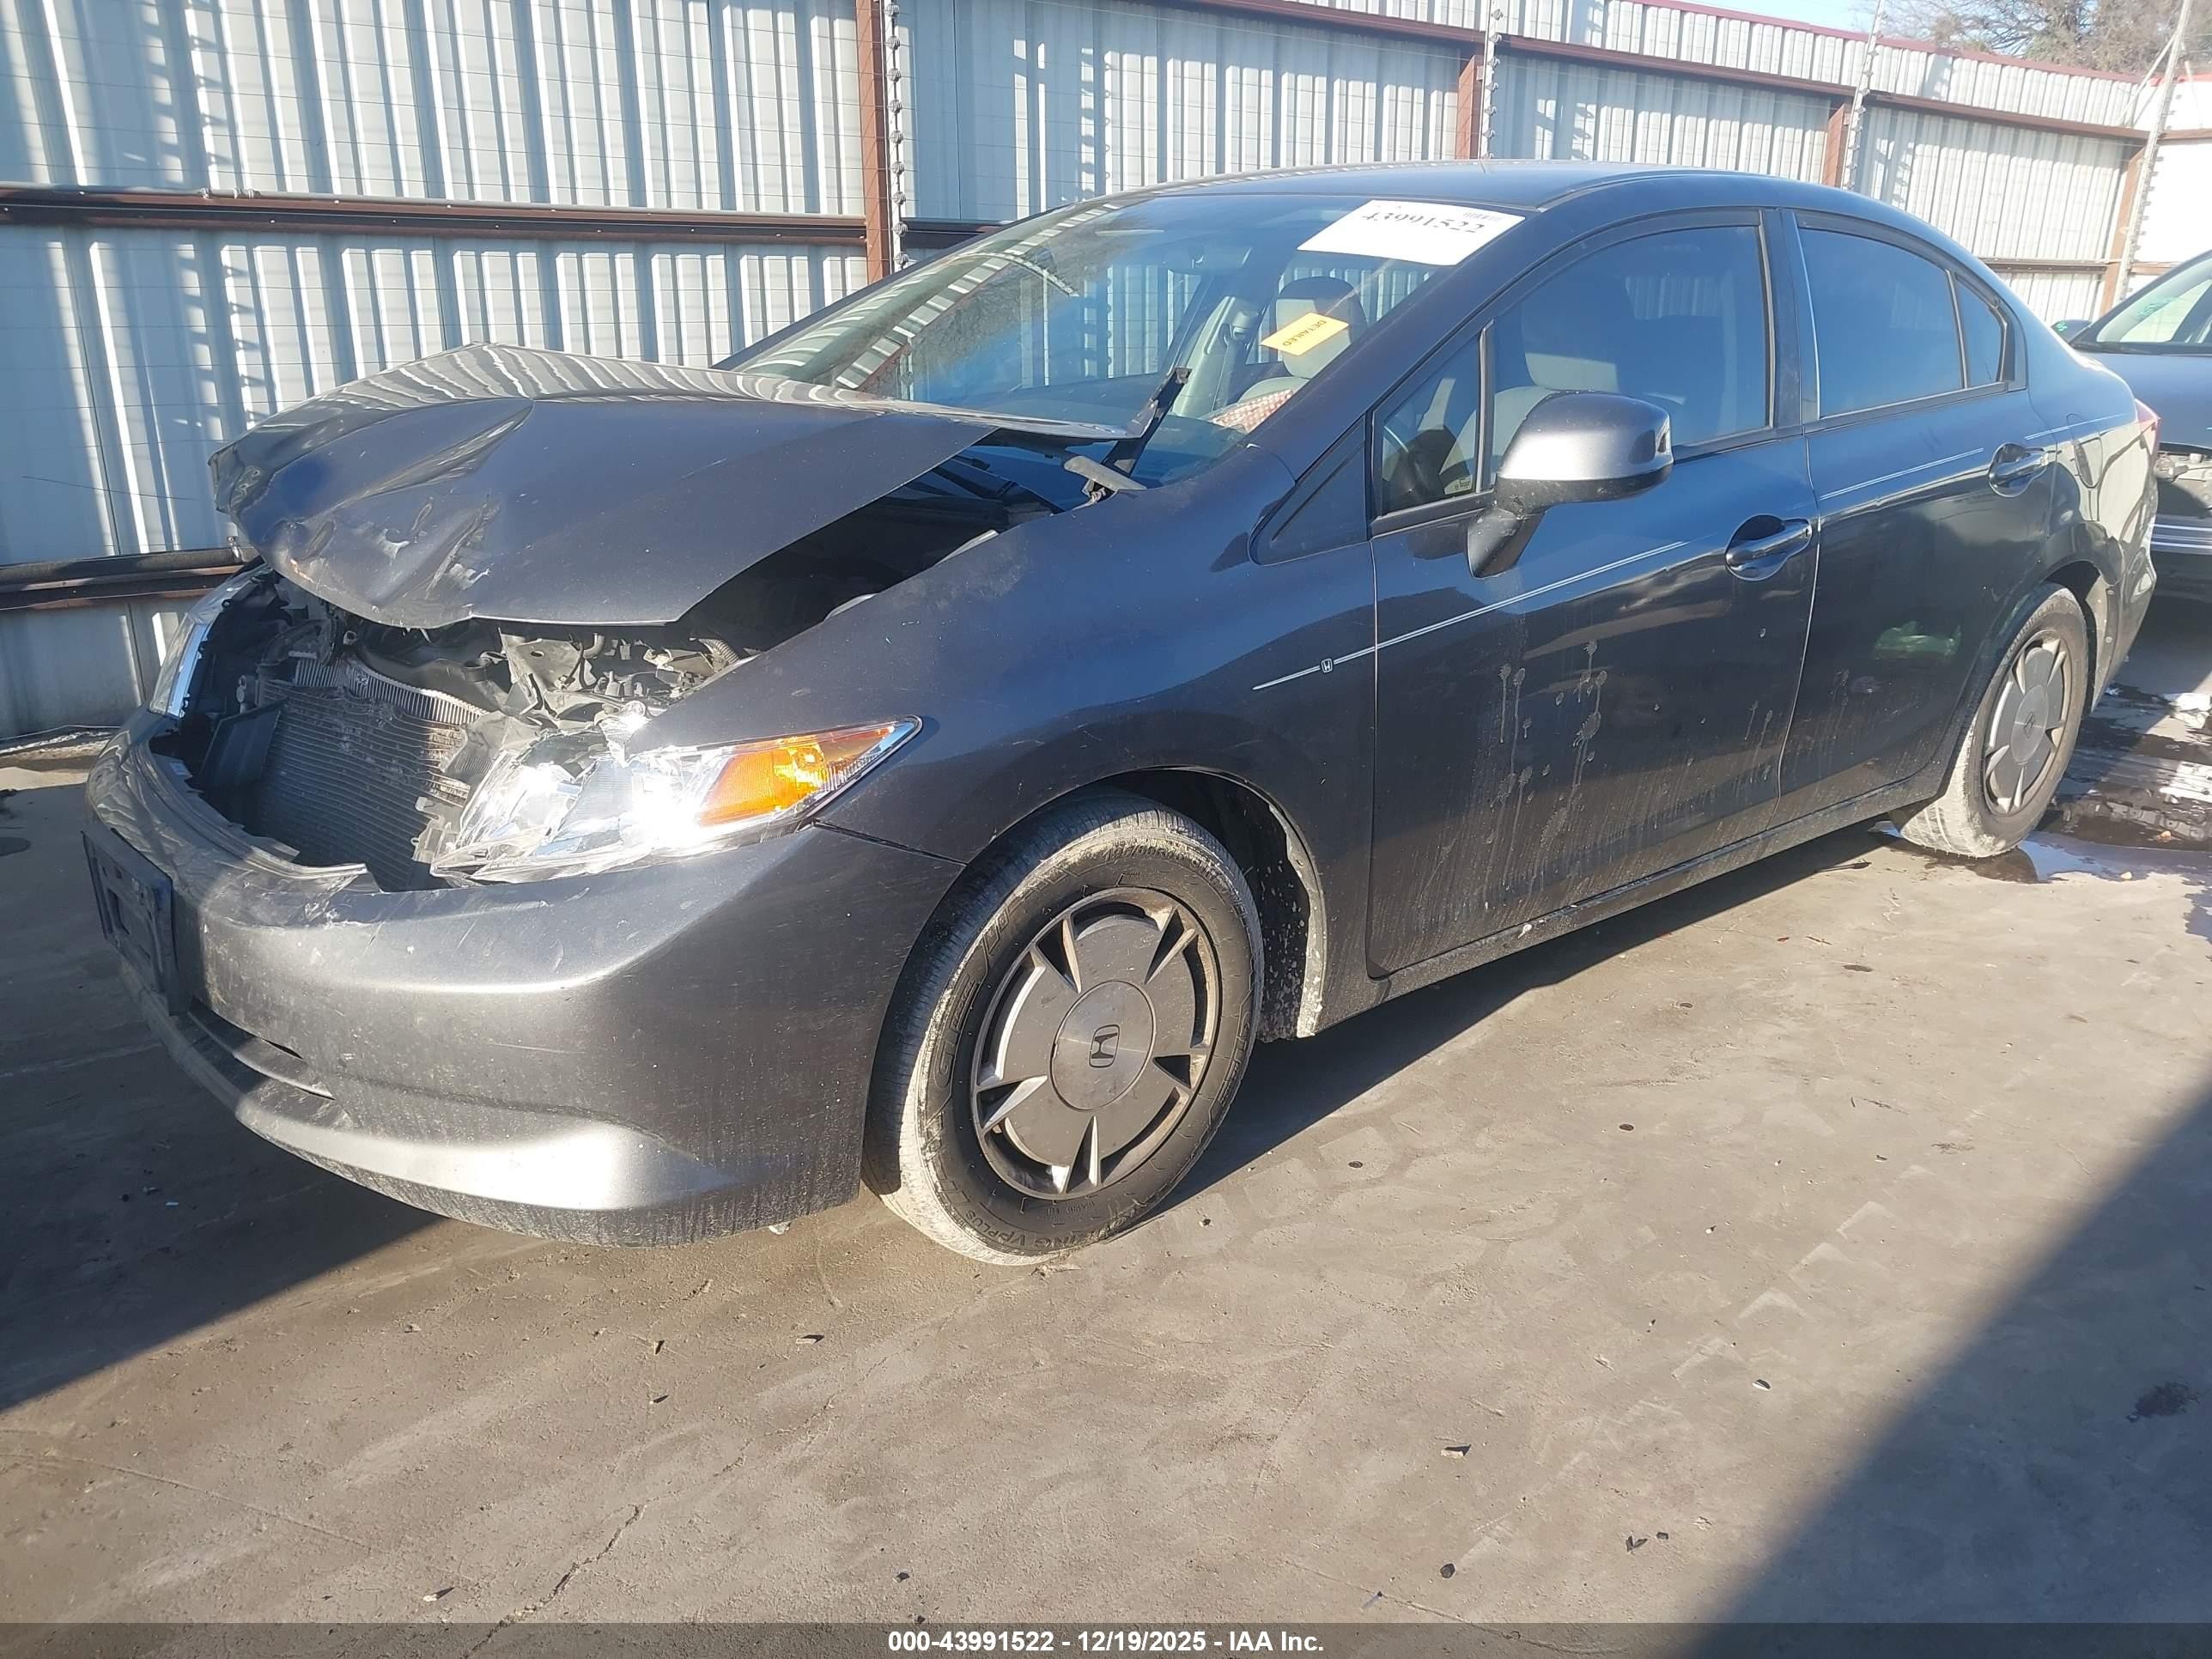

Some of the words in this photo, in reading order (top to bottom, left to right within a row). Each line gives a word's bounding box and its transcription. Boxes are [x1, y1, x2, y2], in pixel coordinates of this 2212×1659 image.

[1362, 212, 1485, 233] 43991522
[1283, 319, 1327, 346] DETAILED
[933, 1028, 961, 1090] GT
[951, 981, 974, 1029] RADIAL
